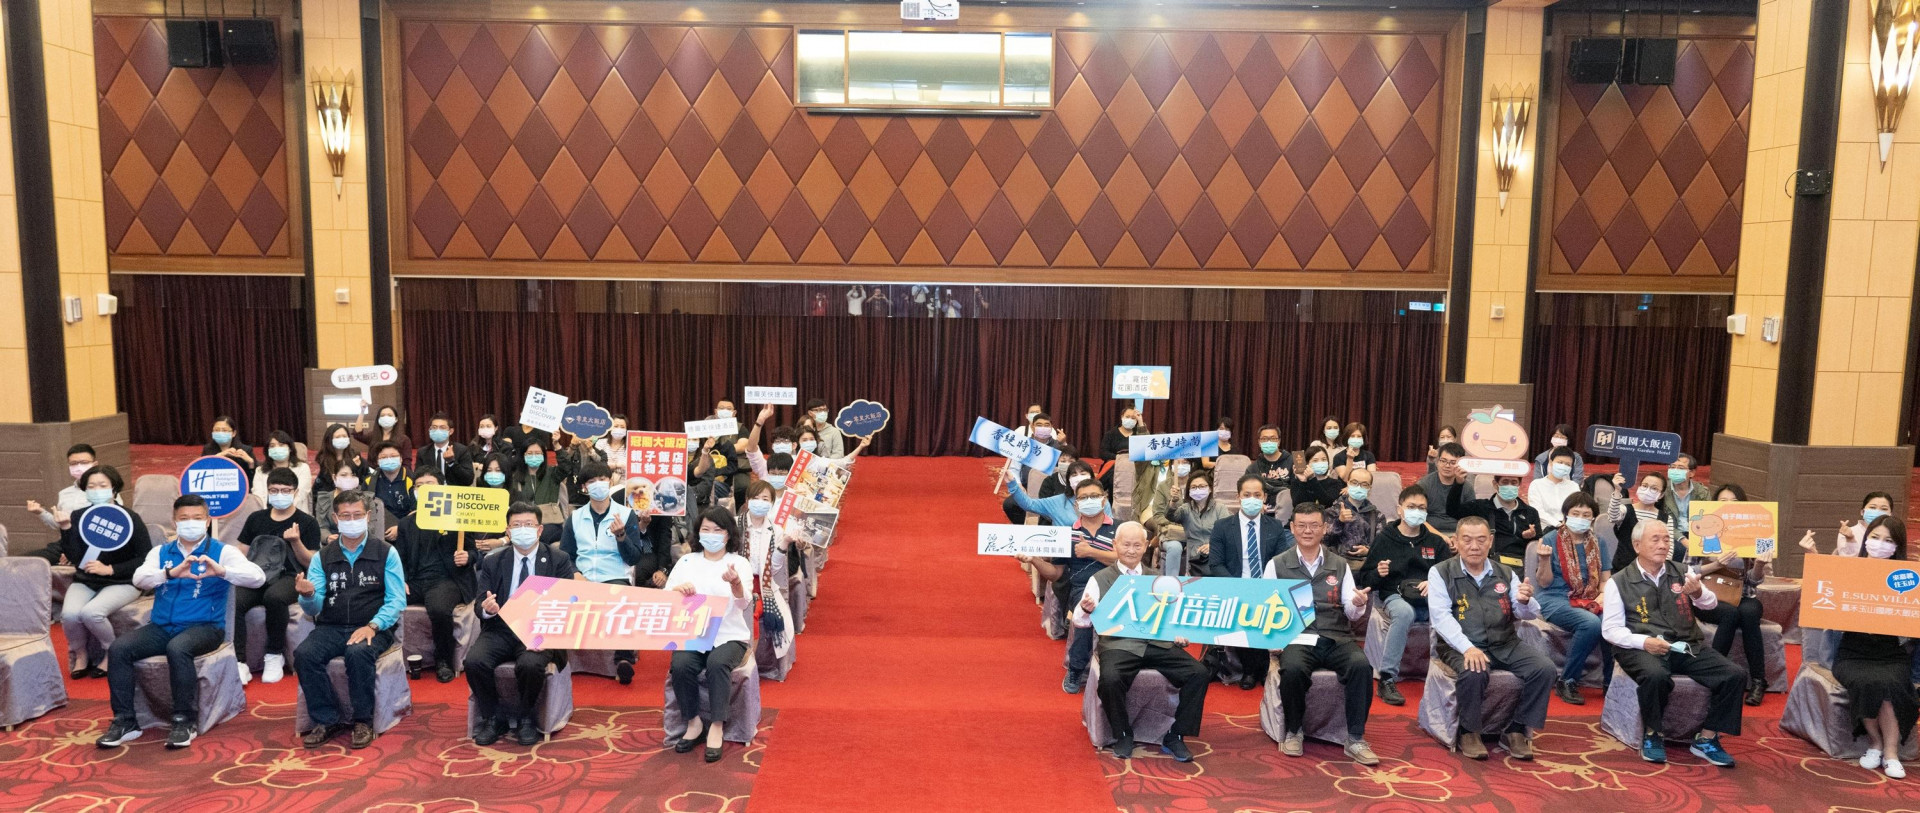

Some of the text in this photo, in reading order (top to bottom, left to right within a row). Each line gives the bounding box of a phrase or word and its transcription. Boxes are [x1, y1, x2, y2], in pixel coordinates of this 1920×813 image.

[457, 493, 485, 501] HOTEL
[456, 502, 500, 511] DISCOVER
[1842, 591, 1920, 605] E.SUN VILLA
